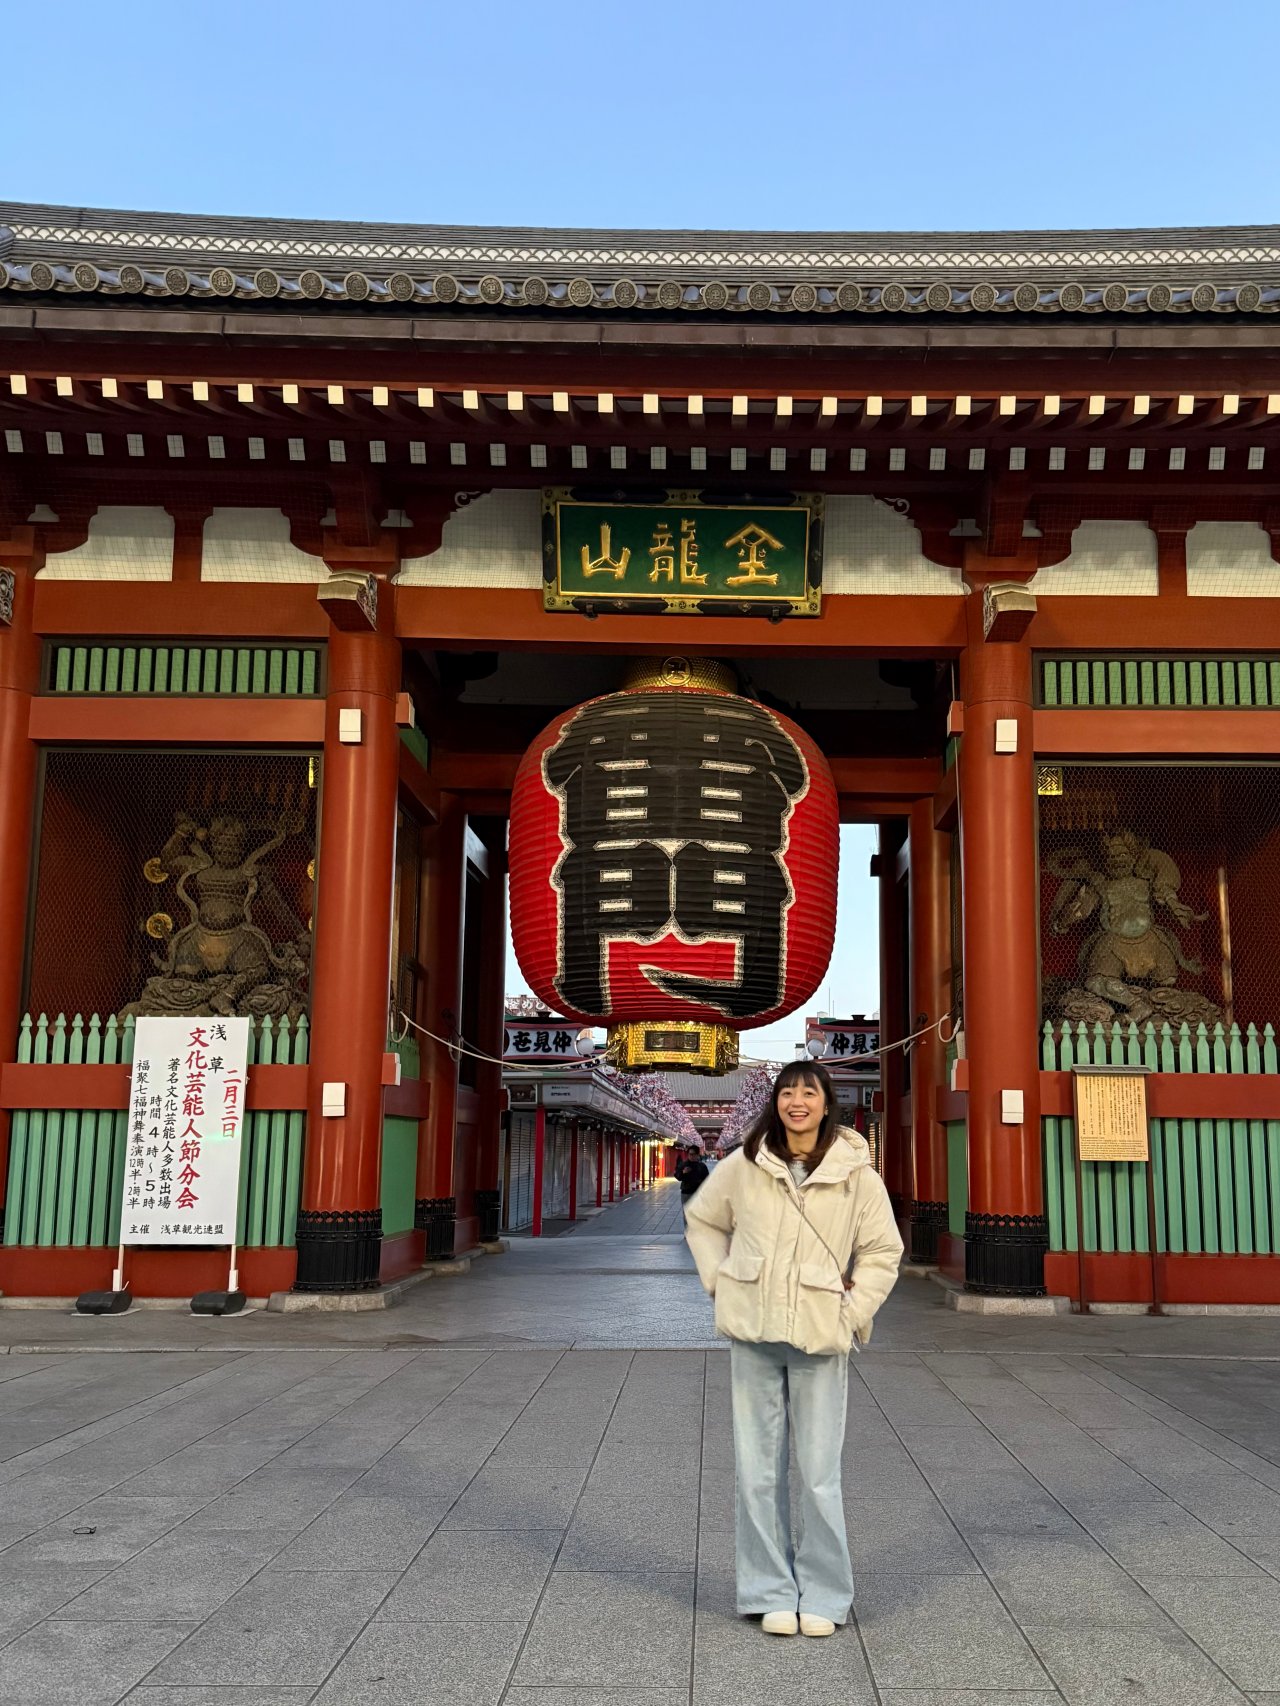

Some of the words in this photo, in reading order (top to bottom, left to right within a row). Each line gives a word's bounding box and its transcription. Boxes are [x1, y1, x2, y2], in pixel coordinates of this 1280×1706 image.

[580, 518, 786, 587] 金龍山
[541, 690, 809, 1019] 雷門
[157, 1057, 181, 1210] 著名文化芸能人多数出場
[175, 1027, 210, 1209] 文化芸能人節分会
[221, 1069, 242, 1138] 二月三日
[129, 1224, 150, 1235] 主催
[160, 1224, 224, 1235] 浅草観光連盟
